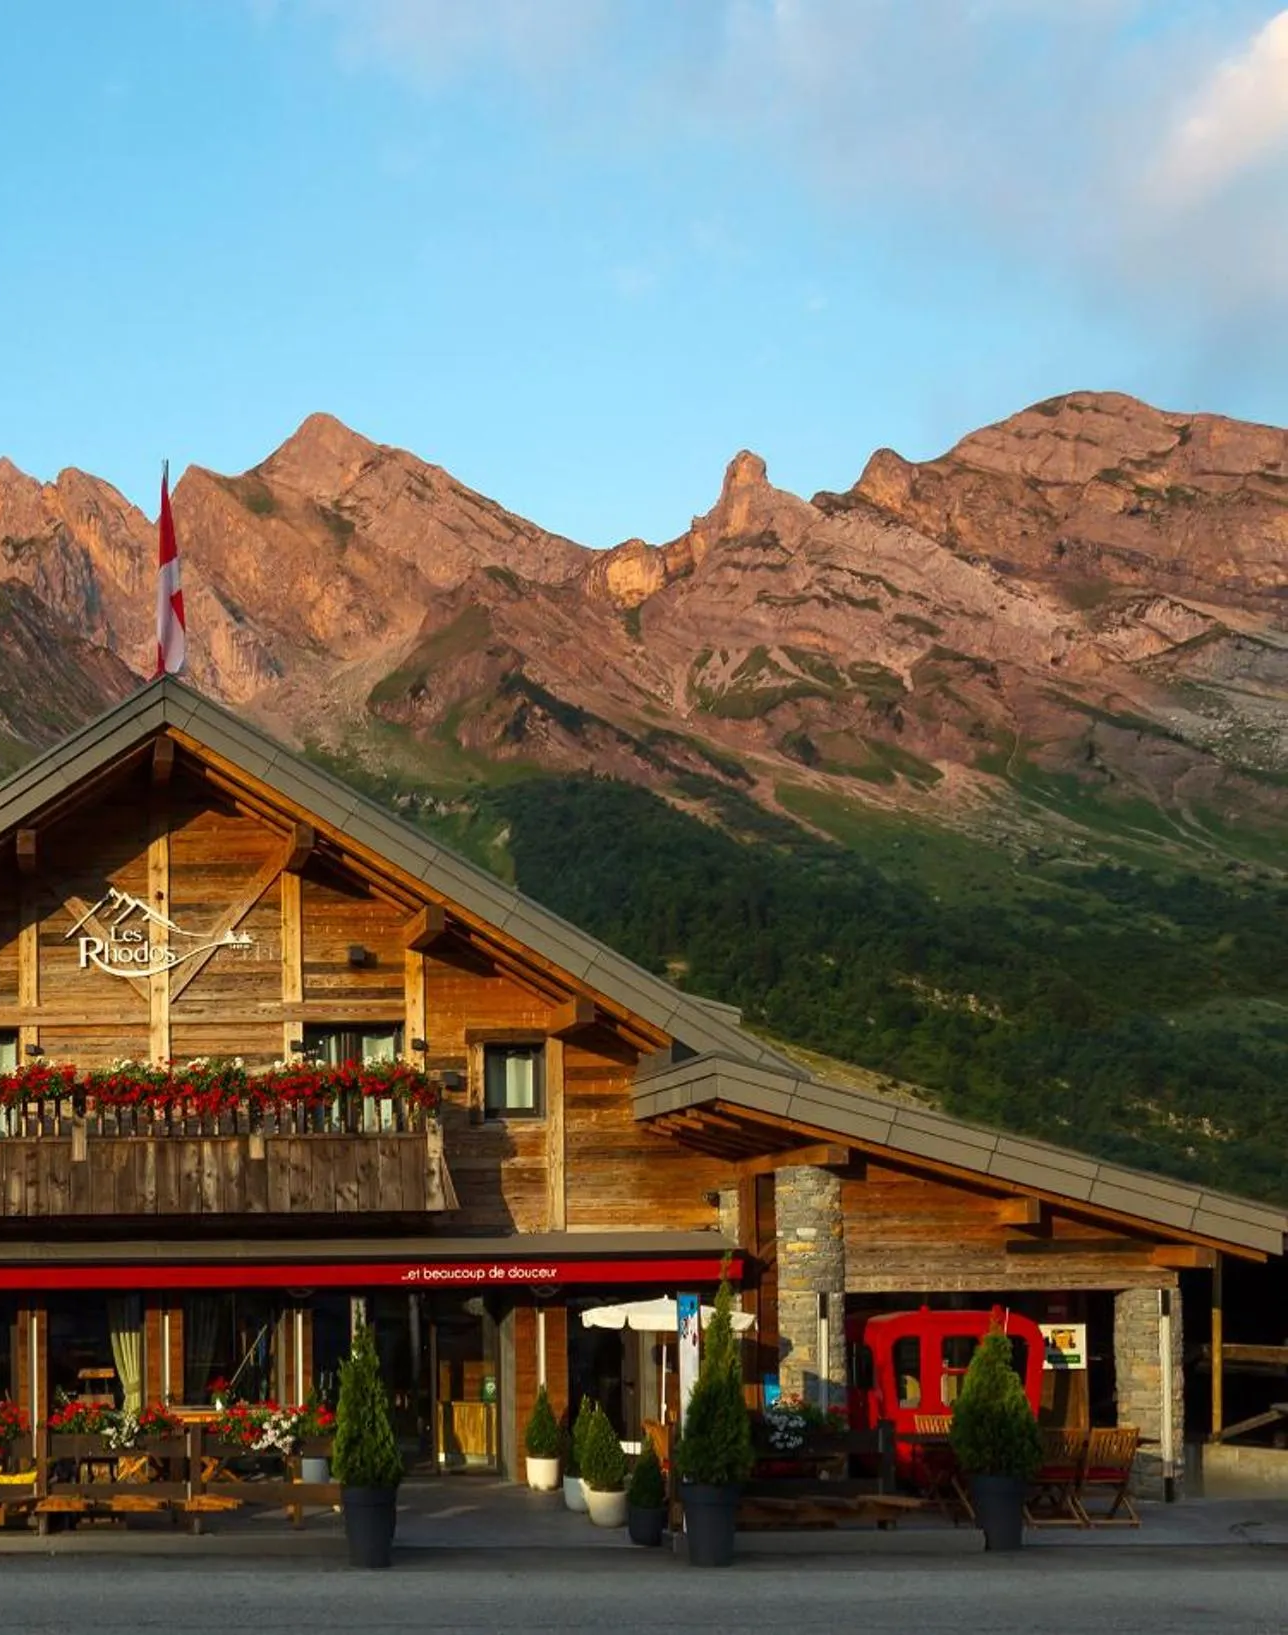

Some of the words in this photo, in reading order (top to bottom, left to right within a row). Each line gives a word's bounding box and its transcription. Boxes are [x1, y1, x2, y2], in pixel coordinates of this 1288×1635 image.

[111, 926, 143, 942] Les
[79, 937, 177, 968] Rhodos
[423, 1266, 486, 1281] beaucoup
[488, 1264, 506, 1279] de
[507, 1265, 558, 1279] douceur
